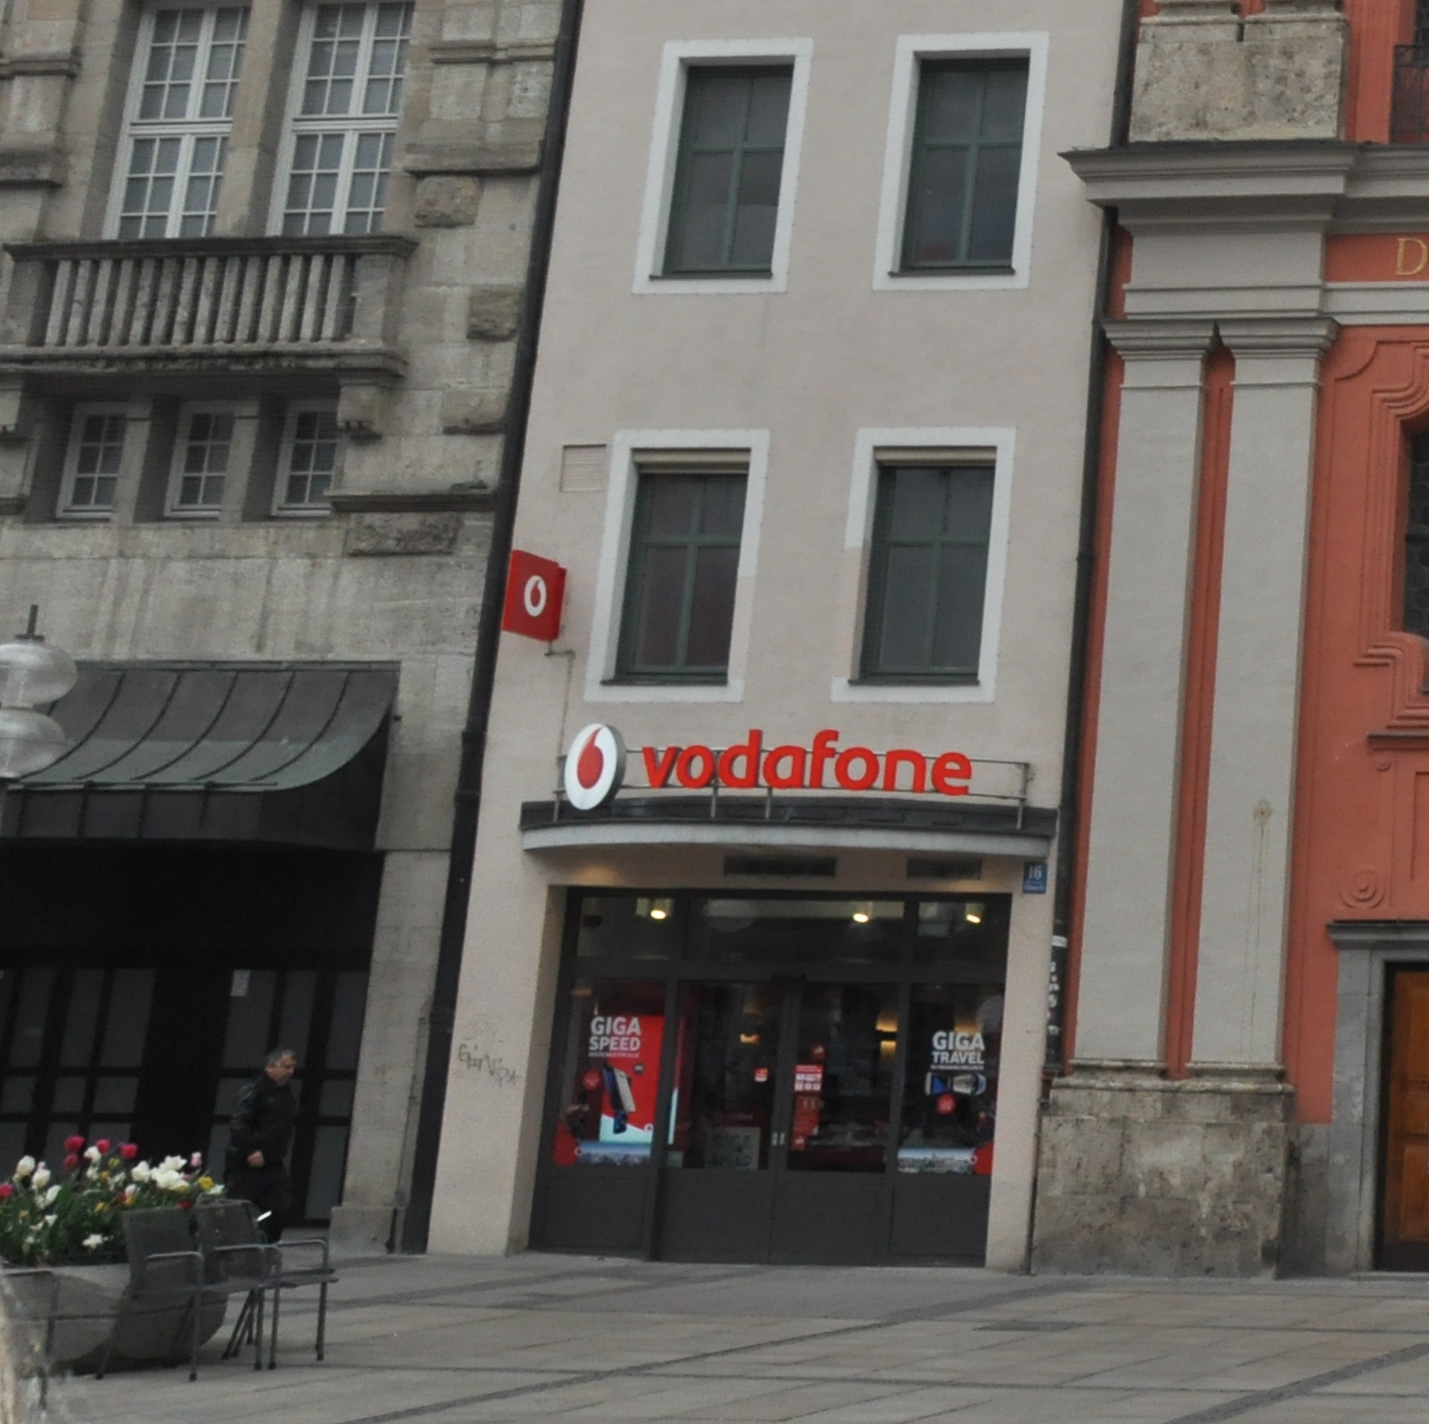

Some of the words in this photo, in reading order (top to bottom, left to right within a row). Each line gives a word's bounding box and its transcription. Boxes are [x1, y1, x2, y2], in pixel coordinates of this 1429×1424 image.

[642, 729, 973, 796] vodafone
[590, 1016, 642, 1036] GIGA
[588, 1036, 641, 1051] SPEED
[932, 1031, 985, 1051] GIGA
[932, 1051, 985, 1065] TRAVEL
